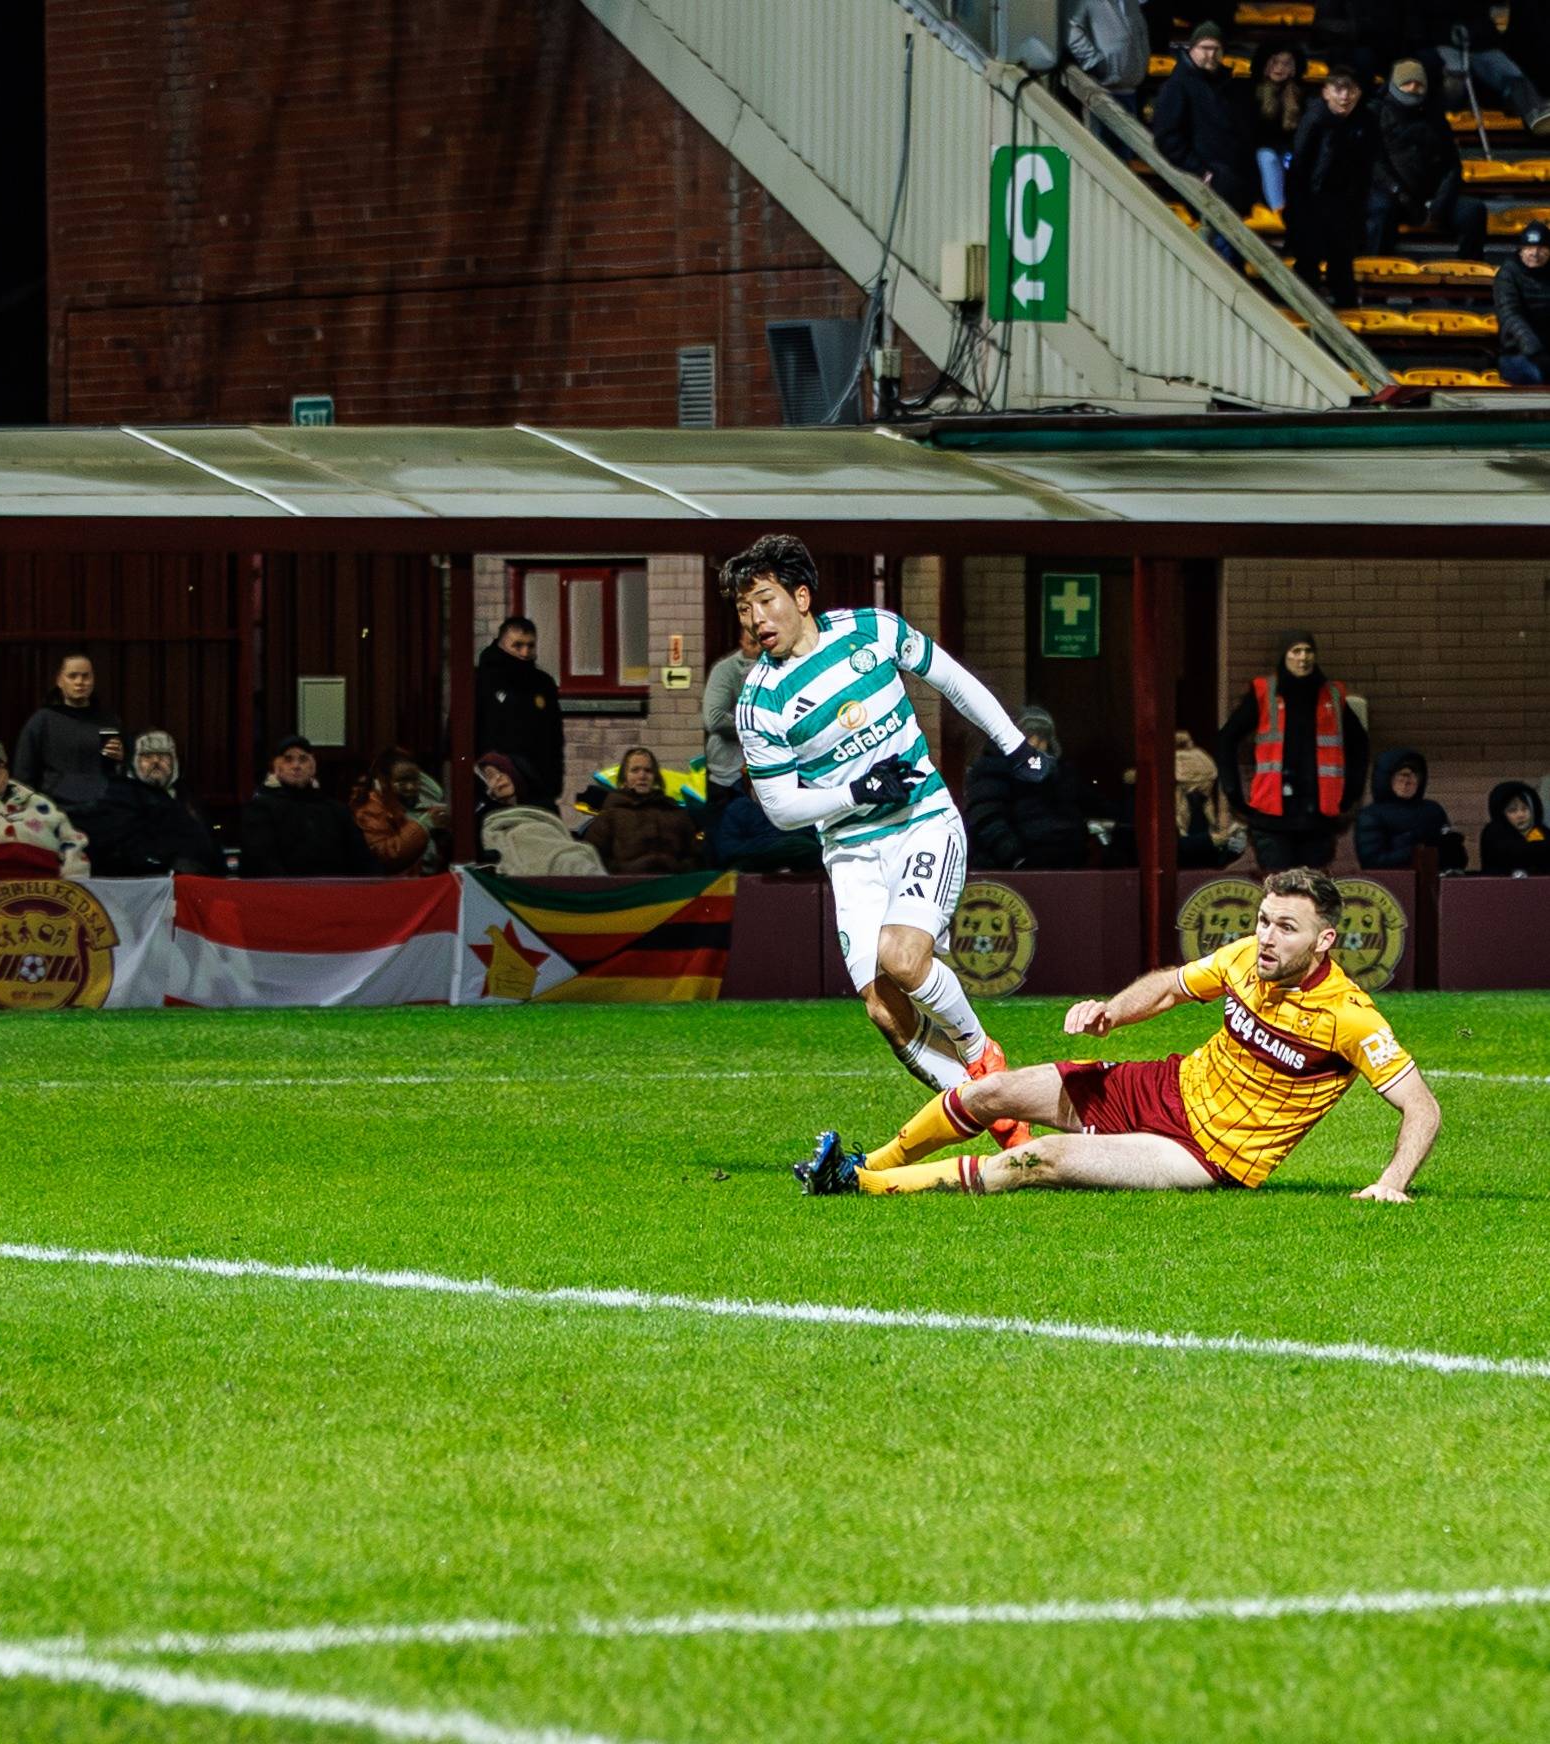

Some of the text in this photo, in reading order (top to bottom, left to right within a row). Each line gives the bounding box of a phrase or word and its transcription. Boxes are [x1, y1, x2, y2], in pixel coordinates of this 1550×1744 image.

[1005, 153, 1054, 266] C
[833, 711, 903, 762] dafabet
[902, 851, 937, 880] 18
[1253, 1028, 1306, 1070] CLAIMS
